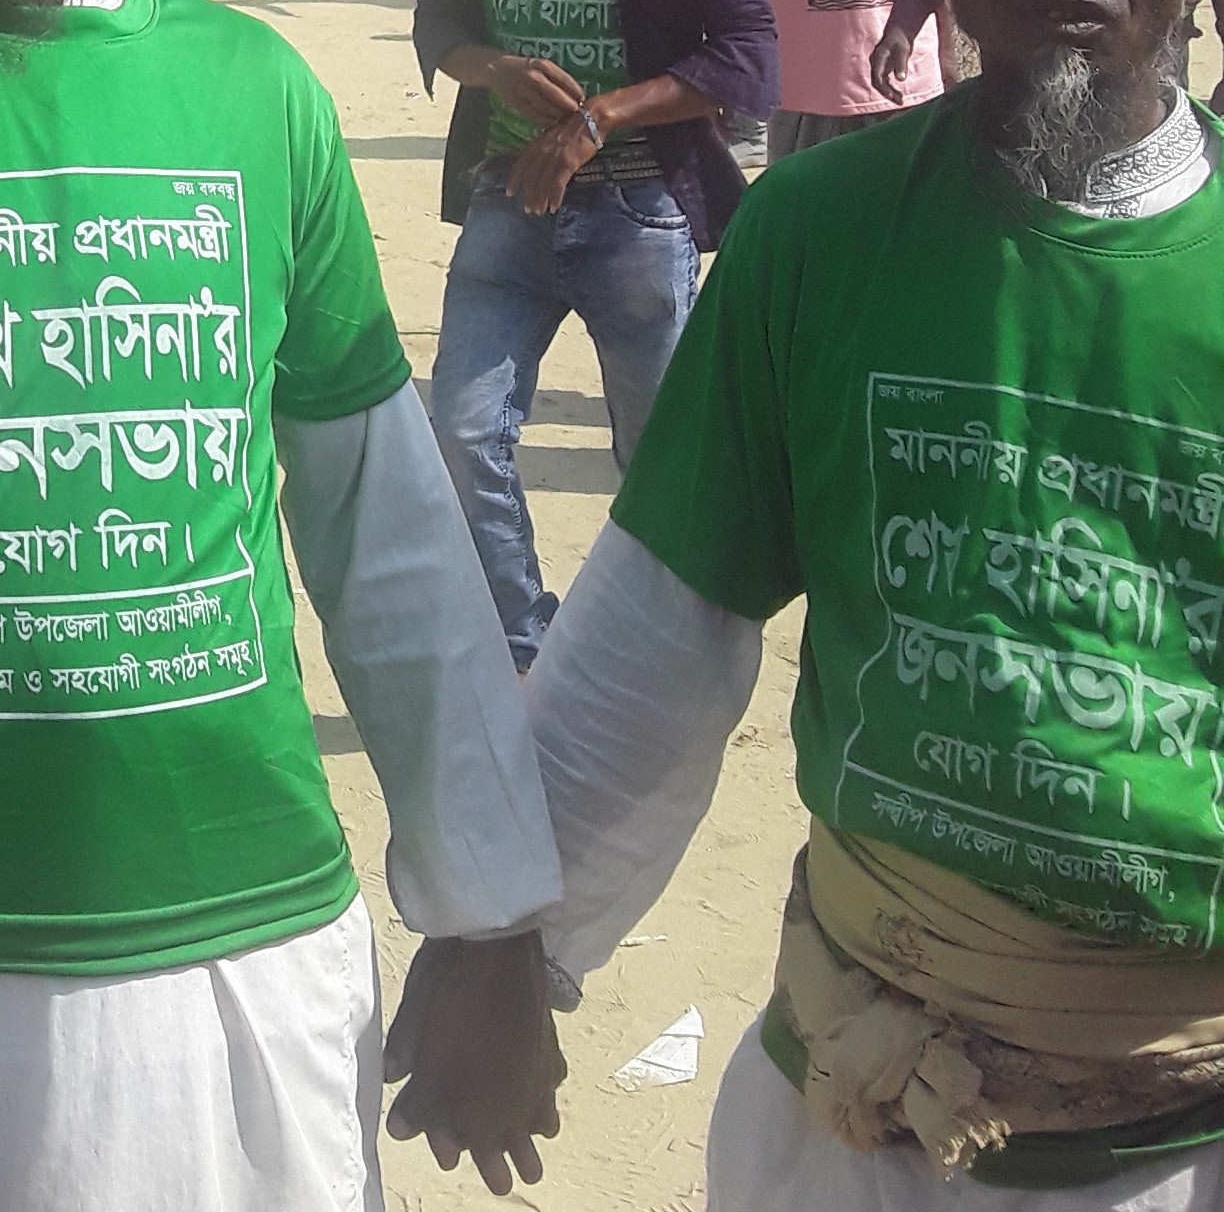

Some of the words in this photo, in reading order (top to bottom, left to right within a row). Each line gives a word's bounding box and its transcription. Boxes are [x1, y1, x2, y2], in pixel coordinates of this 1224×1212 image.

[172, 180, 195, 197] জয়
[199, 182, 237, 202] বঙ্গবন্ধু
[74, 204, 233, 263] প্রধানমন্ত্রী
[906, 386, 945, 404] বাংলা
[884, 420, 1029, 488] মাননীয়
[93, 508, 172, 570] দিন
[13, 607, 110, 643] উপজেলা
[115, 590, 233, 637] আওয়ামীলীগ,
[23, 670, 44, 694] ও
[49, 653, 142, 696] সহযোগী
[146, 643, 212, 688] সংগঠন
[892, 612, 1218, 769] জনসভায়
[913, 731, 1000, 792] যোগ
[1010, 738, 1107, 815] দিন
[872, 791, 928, 833] সন্দ্বীপ
[931, 807, 1018, 865] উপজেলা
[1025, 849, 1177, 904] আওয়ামীলীগ,
